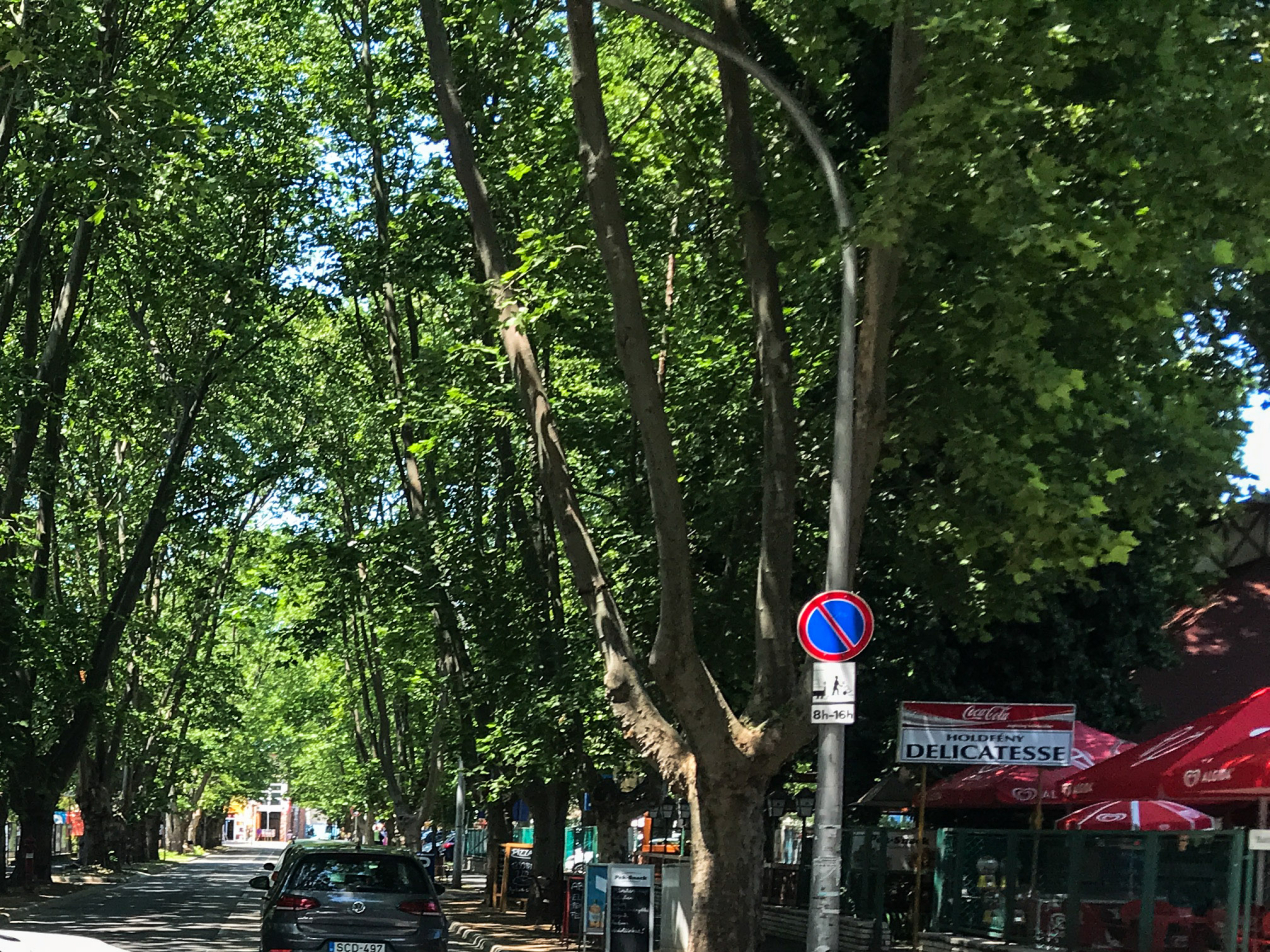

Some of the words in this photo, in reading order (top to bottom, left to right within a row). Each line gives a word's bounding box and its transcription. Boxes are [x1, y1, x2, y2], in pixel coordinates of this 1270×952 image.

[813, 709, 854, 720] 8h-16h
[962, 705, 1012, 721] Coca-Cola
[946, 732, 1025, 743] HOLDFÉNY
[906, 744, 1066, 762] DELICATESSE
